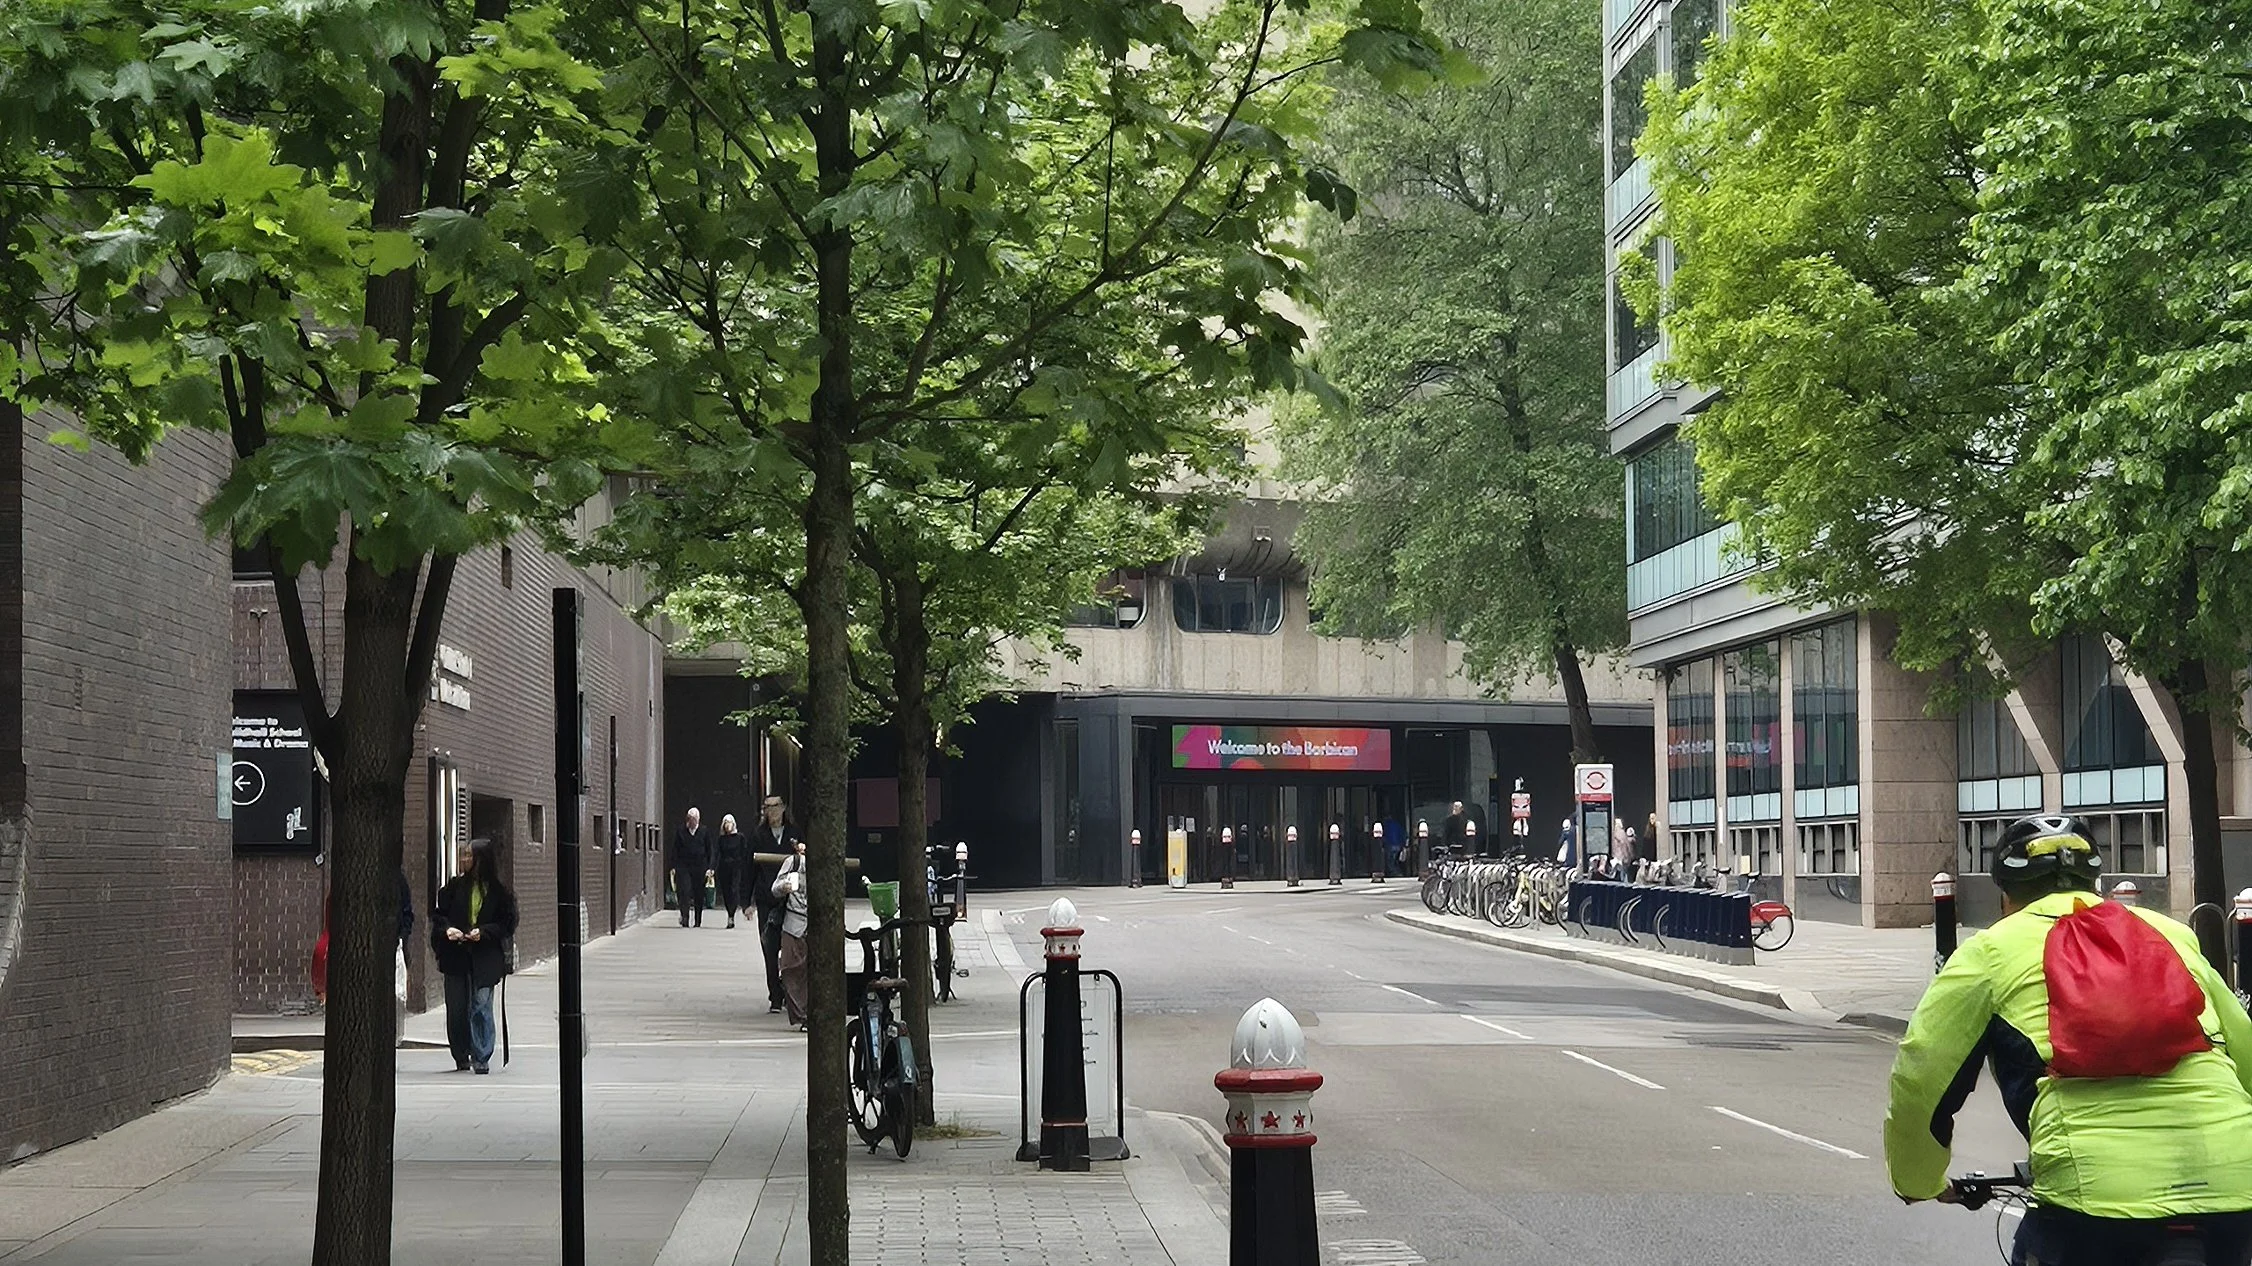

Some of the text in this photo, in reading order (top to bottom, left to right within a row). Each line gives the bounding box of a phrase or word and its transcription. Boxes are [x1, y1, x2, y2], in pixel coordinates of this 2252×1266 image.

[232, 716, 266, 726] elcome
[1208, 739, 1357, 756] Welcome to the Barbican
